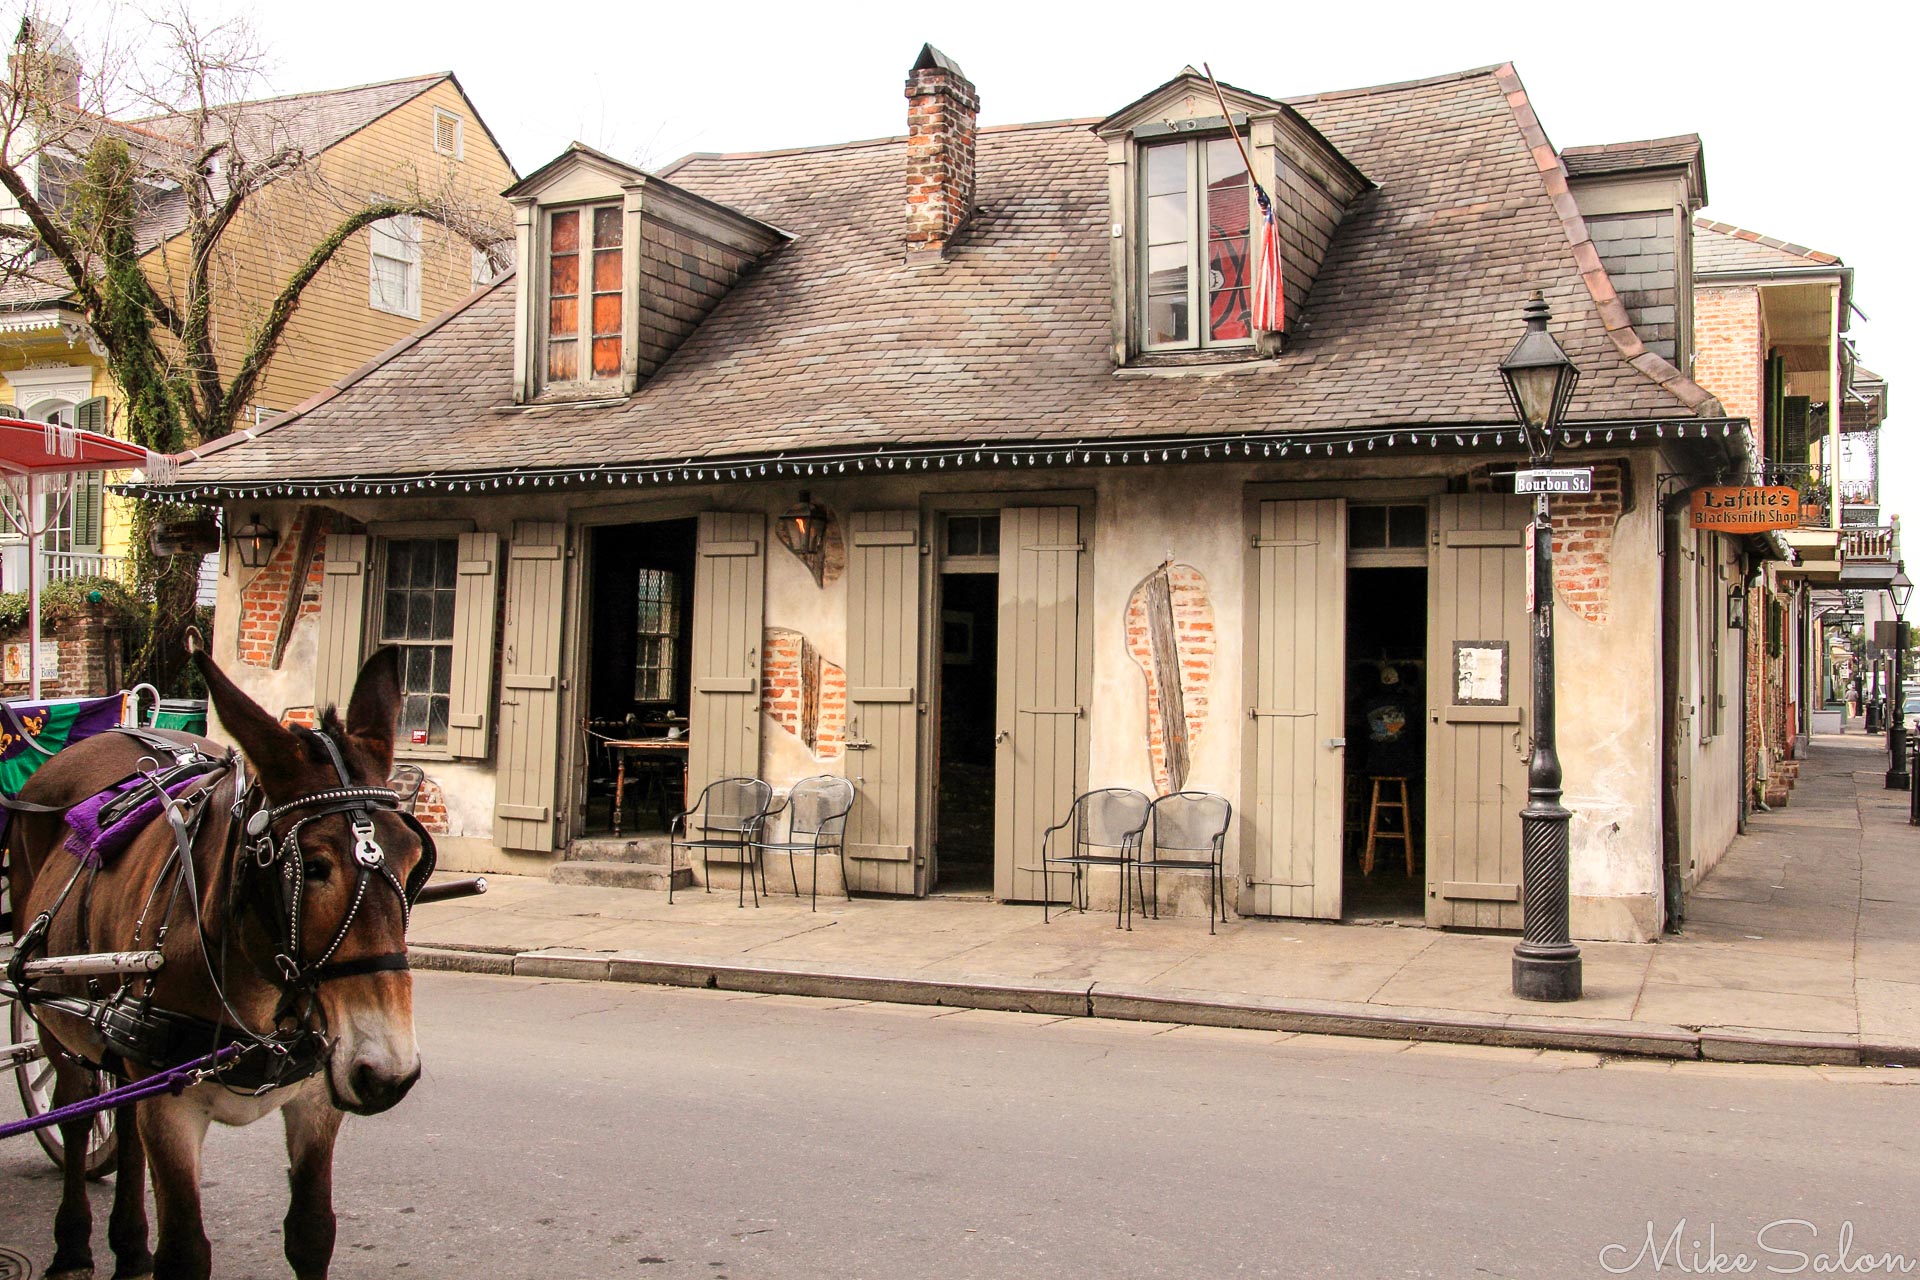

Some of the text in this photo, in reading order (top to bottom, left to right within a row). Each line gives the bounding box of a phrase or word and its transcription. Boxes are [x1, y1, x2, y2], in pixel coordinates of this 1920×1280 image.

[1517, 476, 1589, 492] Bourbon St.
[1703, 488, 1790, 509] Lafitte's
[1695, 509, 1797, 525] Blacksmith Shop
